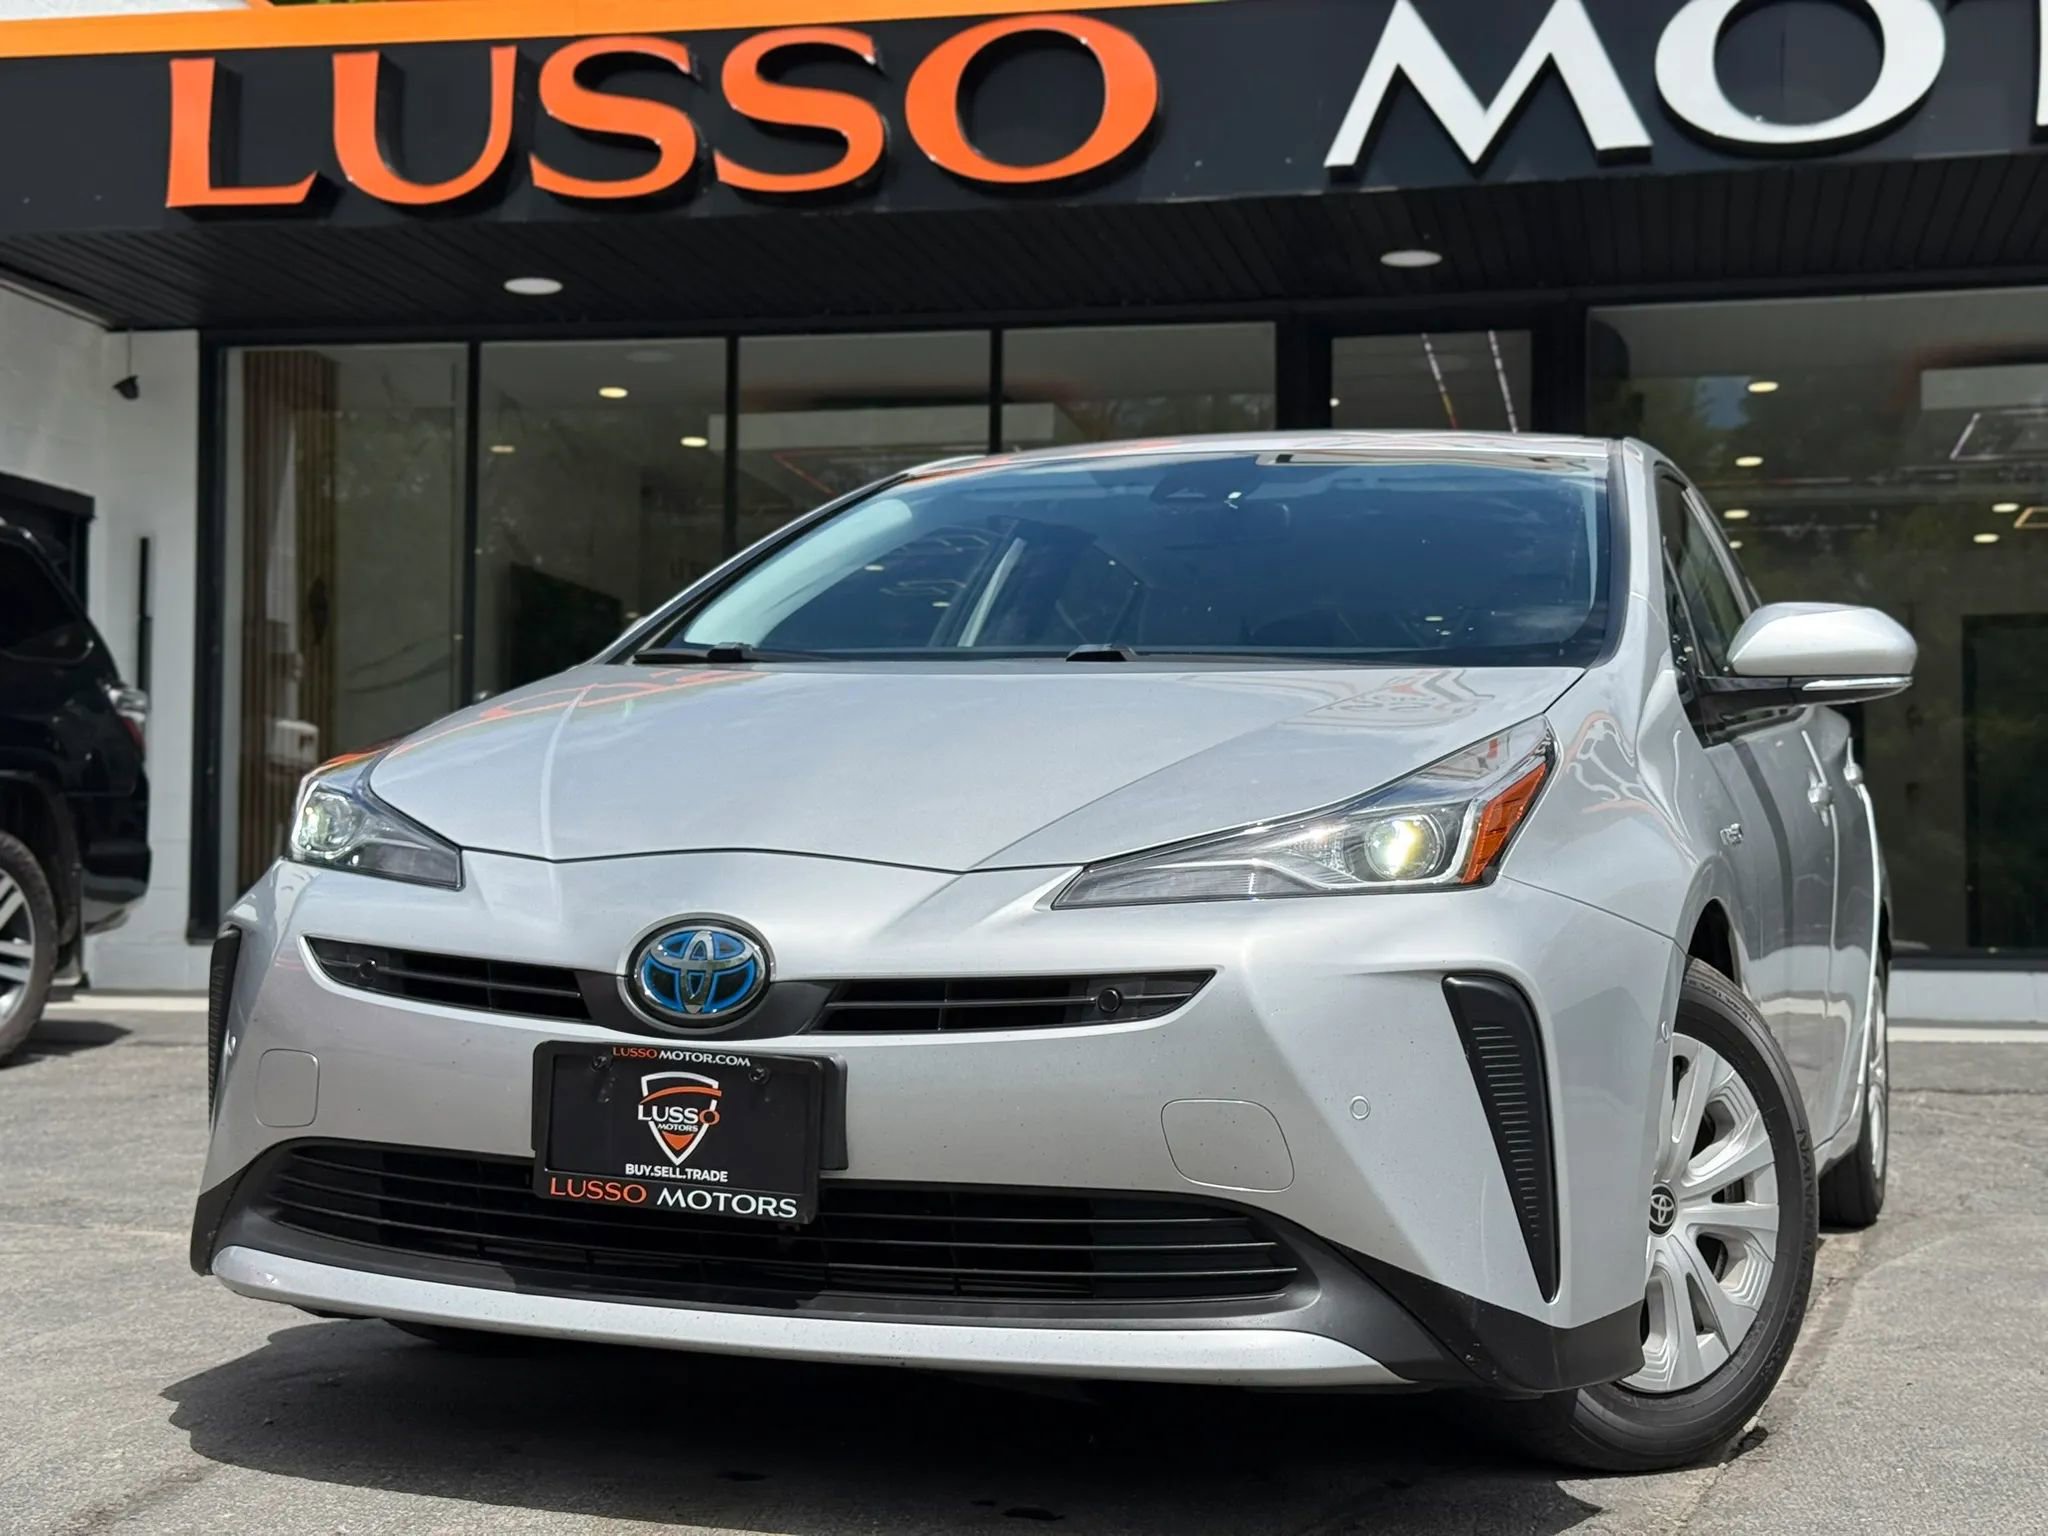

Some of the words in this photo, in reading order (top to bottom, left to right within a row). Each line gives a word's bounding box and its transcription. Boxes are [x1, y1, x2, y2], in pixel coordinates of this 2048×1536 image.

[165, 13, 1160, 209] LUSSO
[1324, 0, 2048, 170] MO
[637, 1104, 720, 1126] LUSSO
[657, 1123, 699, 1133] MOTORS
[625, 1163, 728, 1183] BUY.SELL.TRADE
[550, 1177, 648, 1204] LUSSO
[656, 1187, 798, 1218] MOTORS
